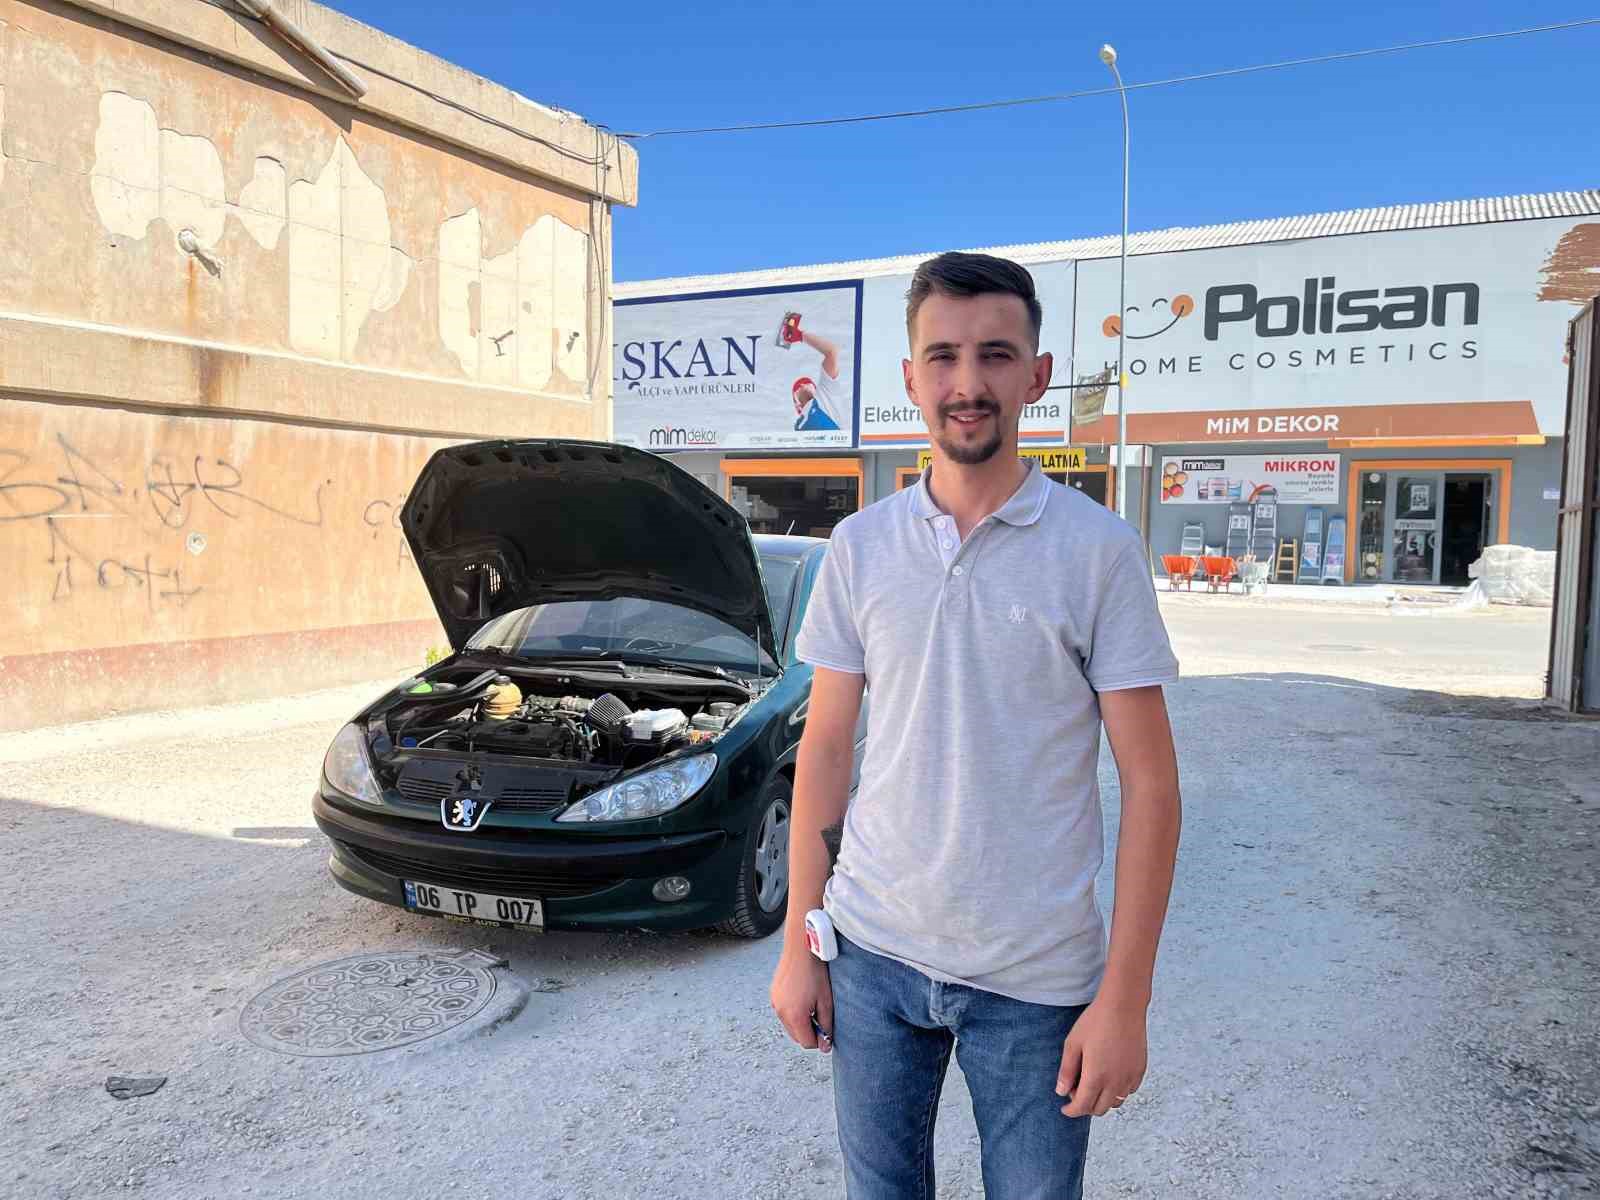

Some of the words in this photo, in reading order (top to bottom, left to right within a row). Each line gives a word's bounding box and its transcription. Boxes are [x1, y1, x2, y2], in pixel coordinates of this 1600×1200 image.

[1204, 276, 1480, 341] Polisan
[1105, 355, 1203, 377] HOME
[1229, 340, 1479, 371] COSMETICS
[864, 405, 921, 423] Elektri
[1023, 402, 1060, 419] tma
[1257, 414, 1340, 433] DEKOR
[1264, 458, 1336, 472] MİKRON
[416, 885, 440, 908] 06
[450, 891, 477, 915] TP
[496, 898, 535, 924] 007
